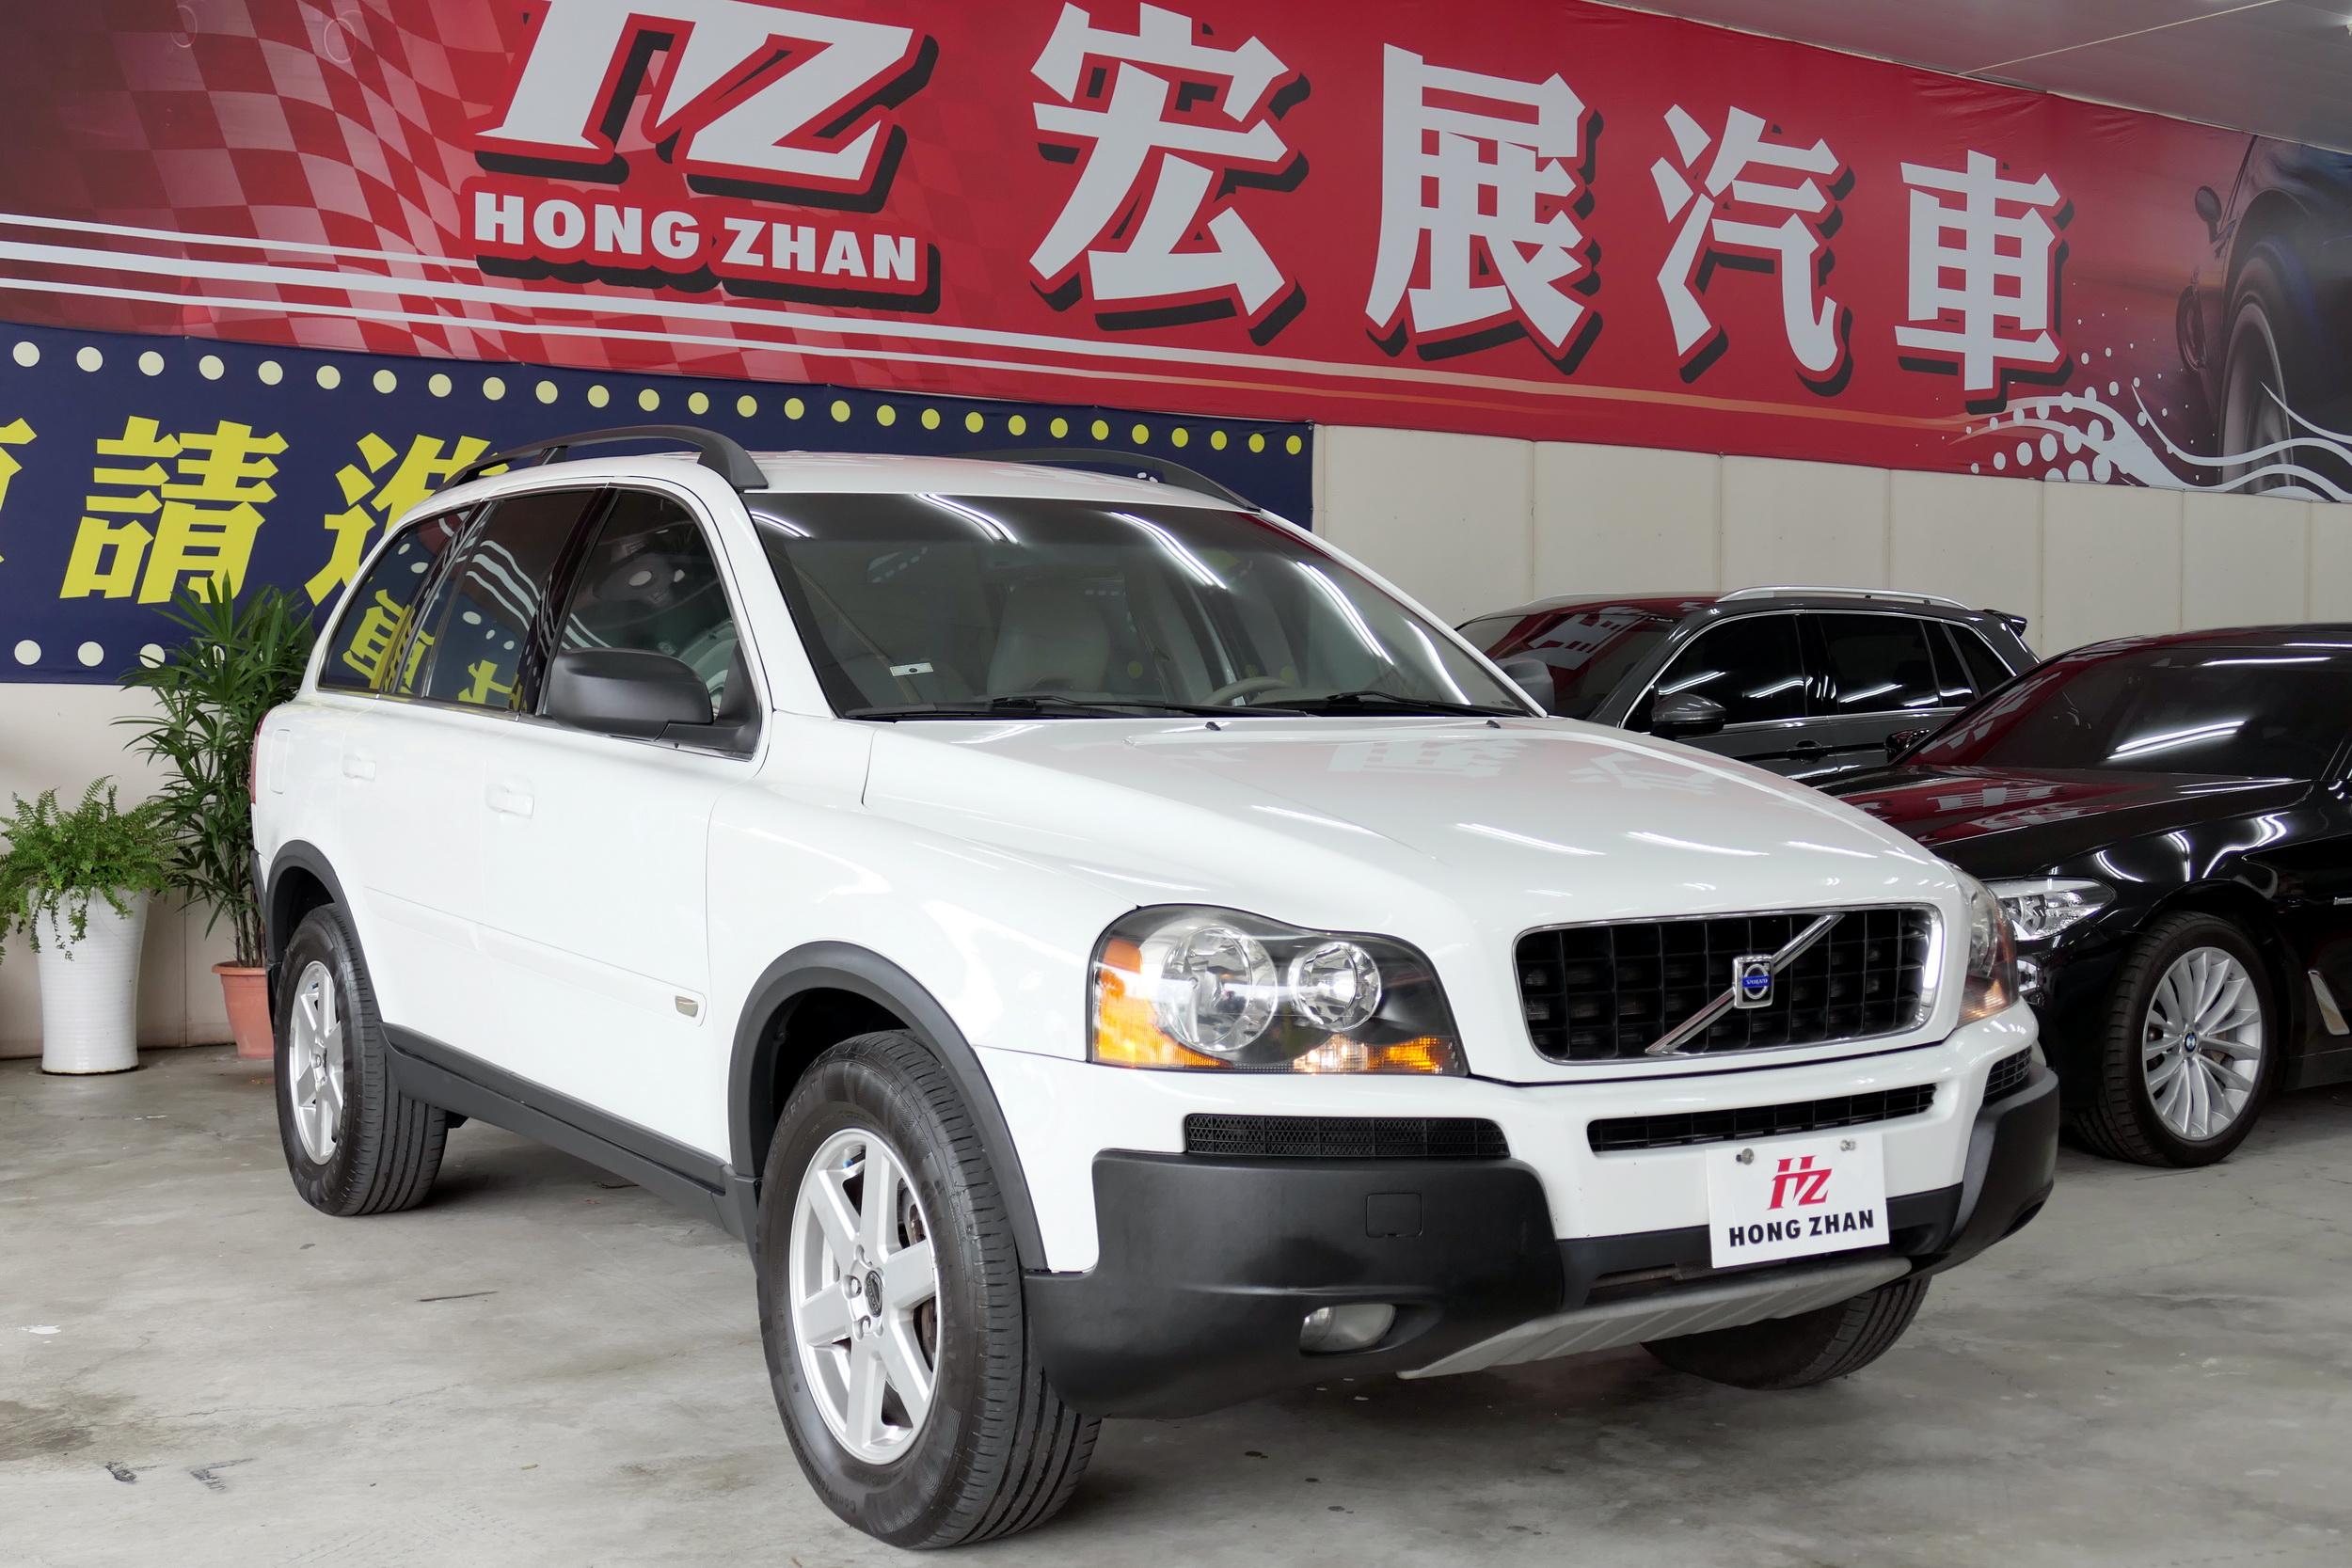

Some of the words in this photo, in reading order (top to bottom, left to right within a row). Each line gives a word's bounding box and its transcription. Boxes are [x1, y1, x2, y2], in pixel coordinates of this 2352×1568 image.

[475, 192, 699, 259] HONG
[722, 216, 916, 281] ZHAN
[1028, 2, 2060, 390] 宏展汽車
[0, 415, 510, 607] 請進
[1728, 1219, 1802, 1247] HONG
[1808, 1209, 1874, 1237] ZHAN
